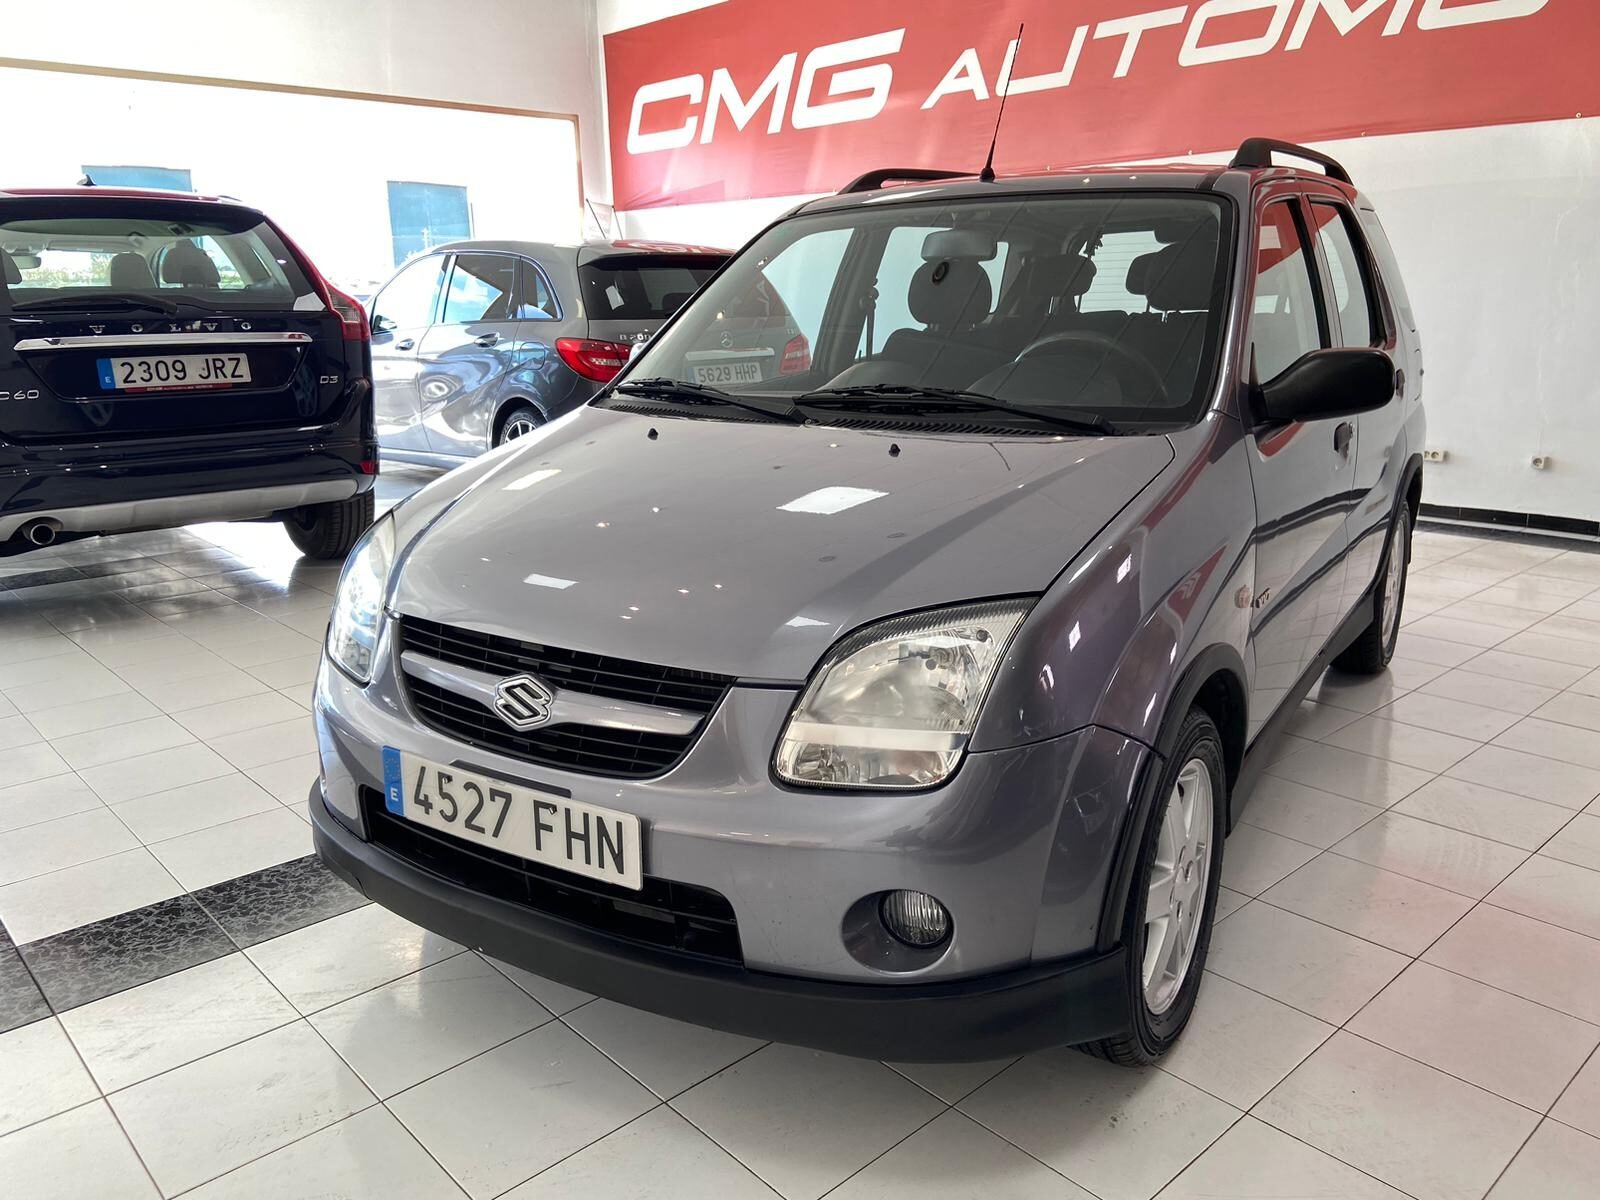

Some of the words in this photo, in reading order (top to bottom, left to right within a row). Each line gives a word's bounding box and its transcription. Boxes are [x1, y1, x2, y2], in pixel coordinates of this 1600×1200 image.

[626, 28, 905, 155] CMG
[89, 321, 252, 334] VOLVO
[120, 359, 187, 384] 2309
[198, 357, 244, 380] JRZ
[320, 375, 339, 384] D3
[698, 366, 732, 383] 5629
[735, 364, 758, 381] HHP
[390, 787, 398, 801] E
[413, 765, 512, 838] 4527
[533, 799, 625, 875] FHN
